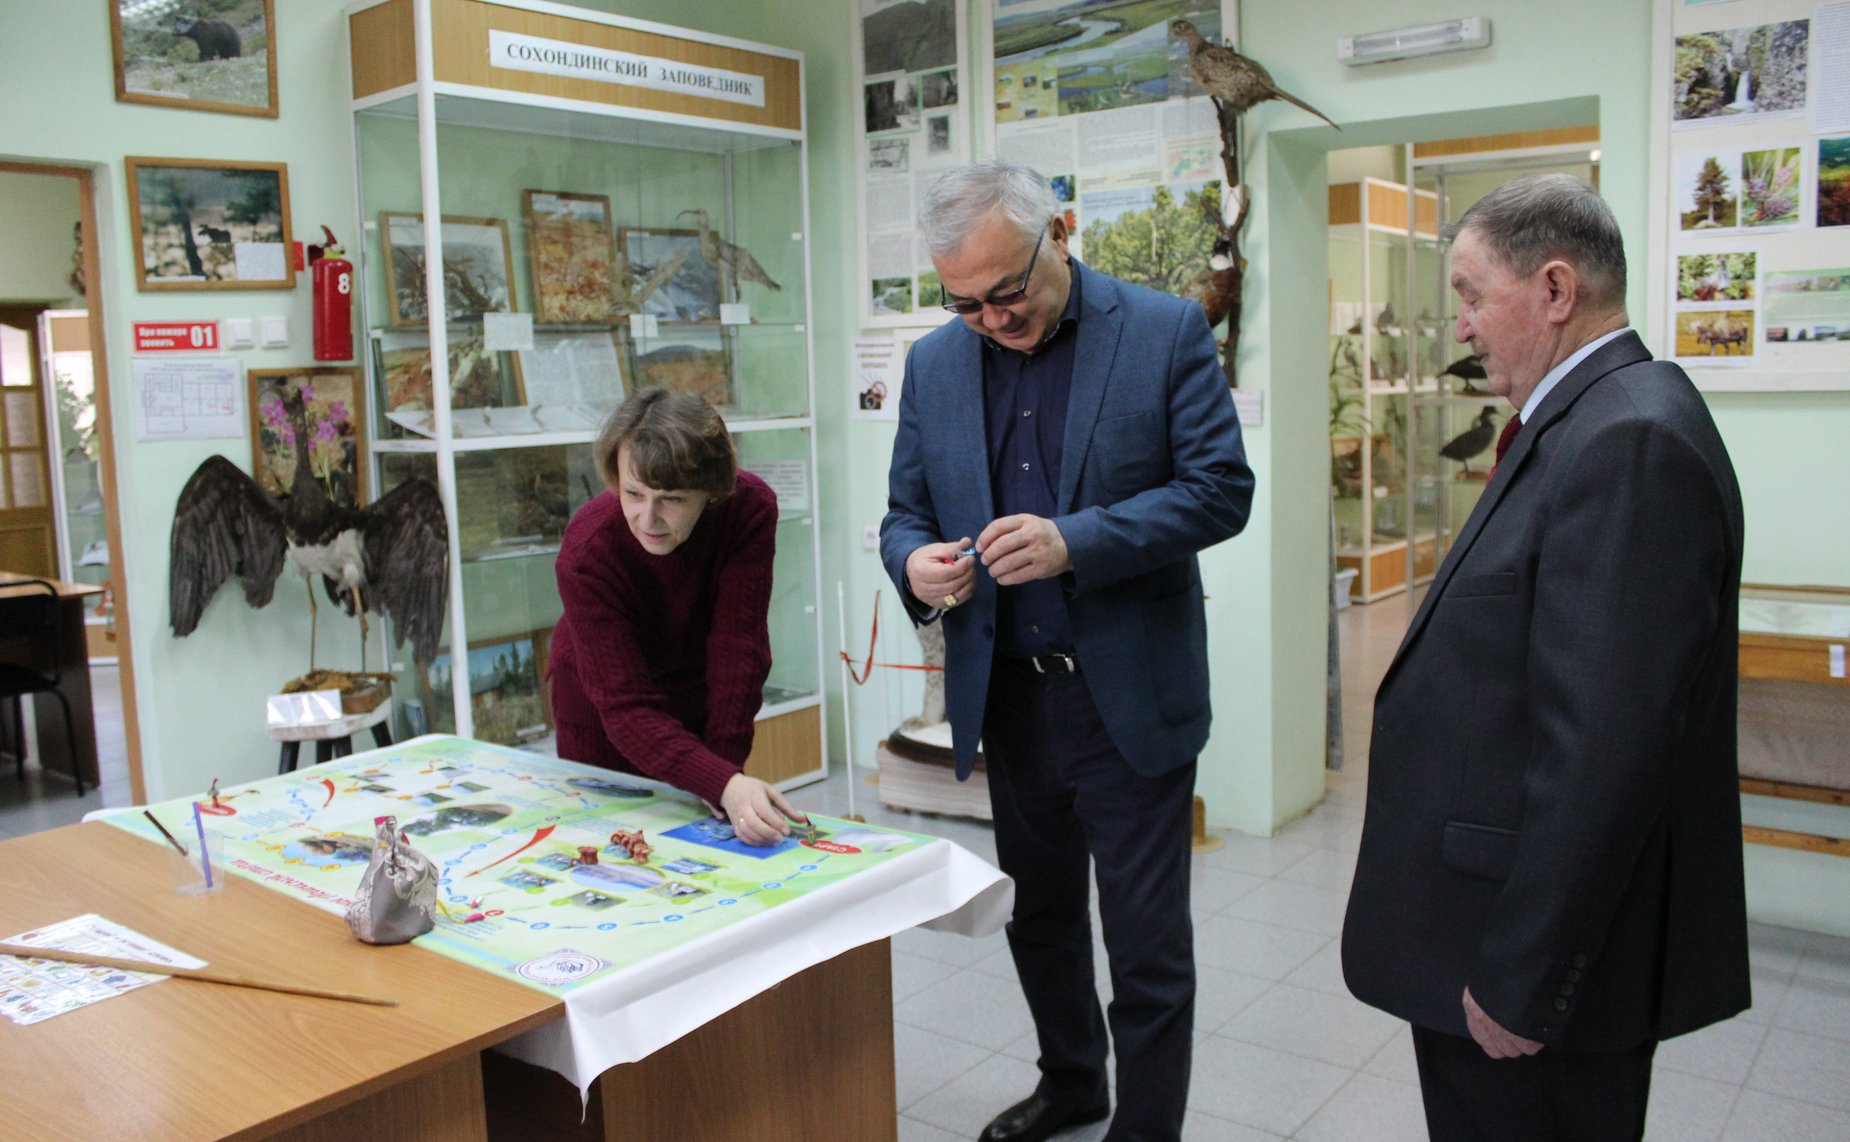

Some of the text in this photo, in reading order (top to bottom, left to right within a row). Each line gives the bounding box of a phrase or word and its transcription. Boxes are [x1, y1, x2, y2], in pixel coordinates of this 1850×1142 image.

[507, 43, 753, 96] СОХОНДИНСКИЙ ЗАПОВЕДНИК
[338, 272, 350, 294] 8
[190, 325, 213, 347] 01
